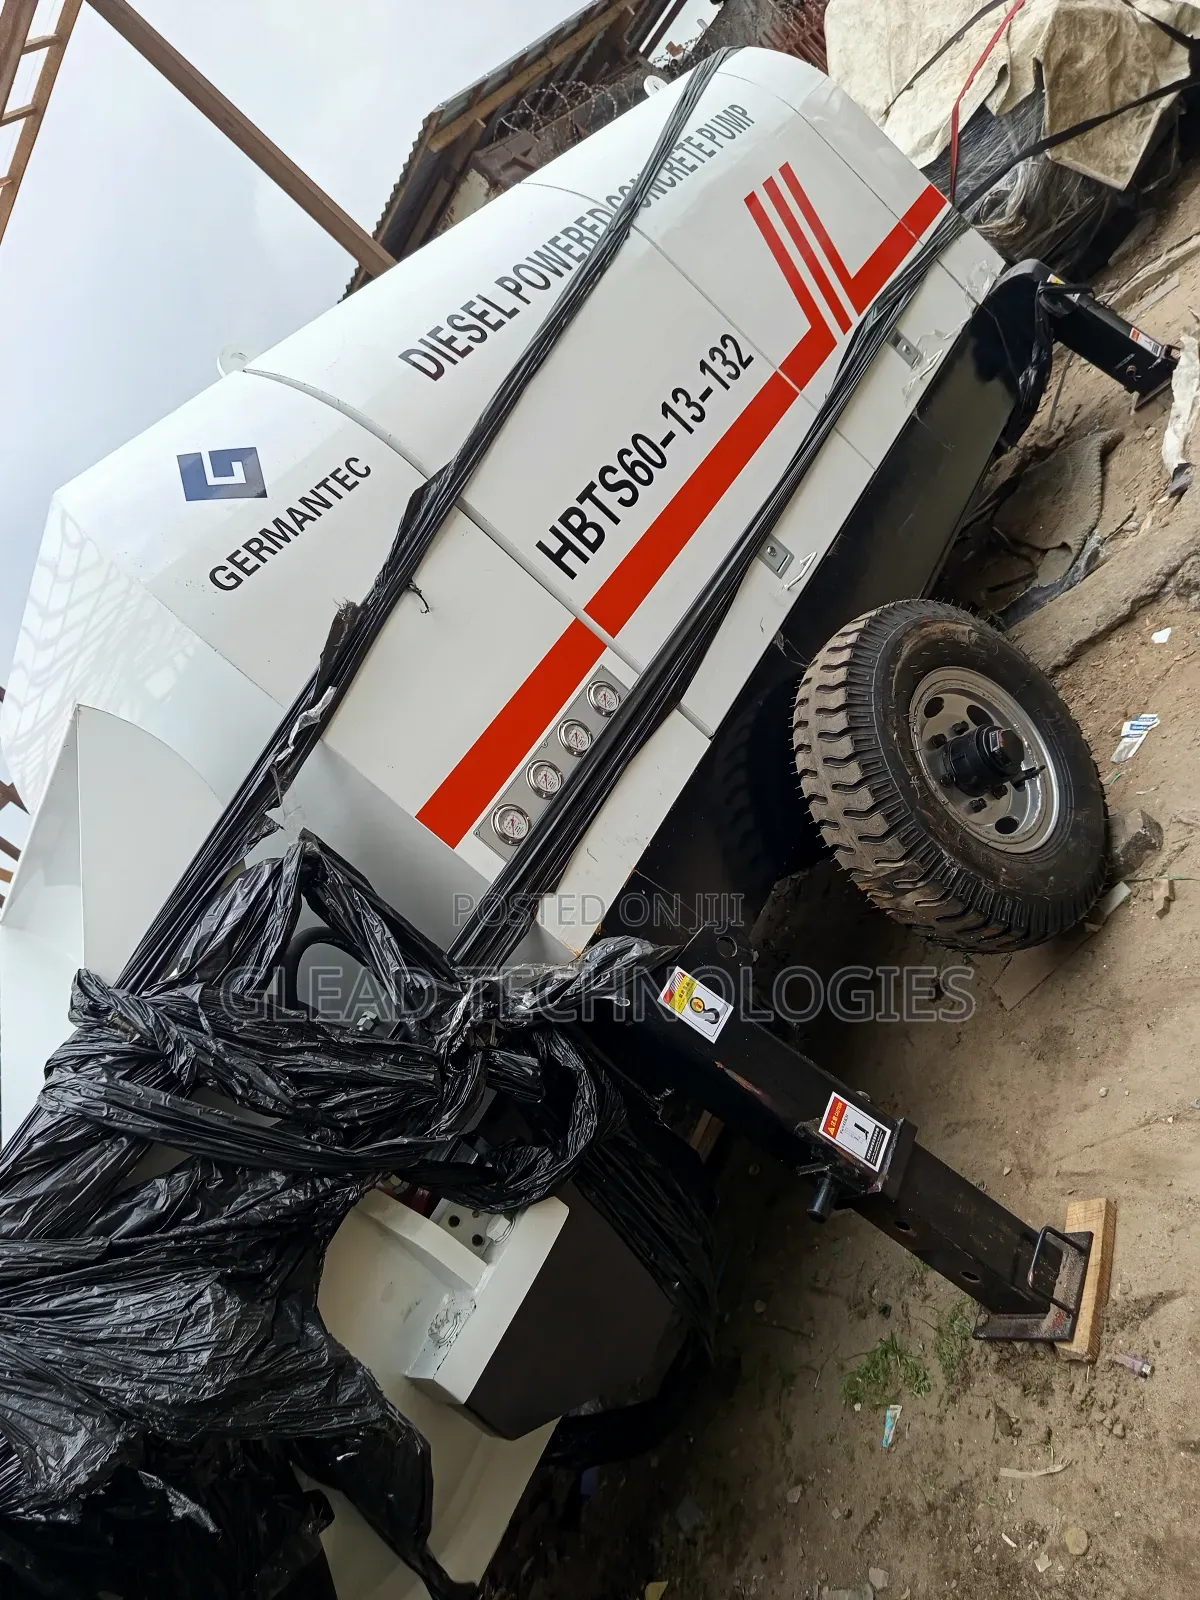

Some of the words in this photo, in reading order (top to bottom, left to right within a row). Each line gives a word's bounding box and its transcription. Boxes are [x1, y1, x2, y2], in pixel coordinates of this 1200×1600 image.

[398, 294, 521, 381] DIESEL
[495, 208, 617, 305] POWERED
[695, 104, 755, 149] PUMP
[209, 457, 371, 591] GERMANTEC
[535, 334, 754, 580] HBTS60-13-132
